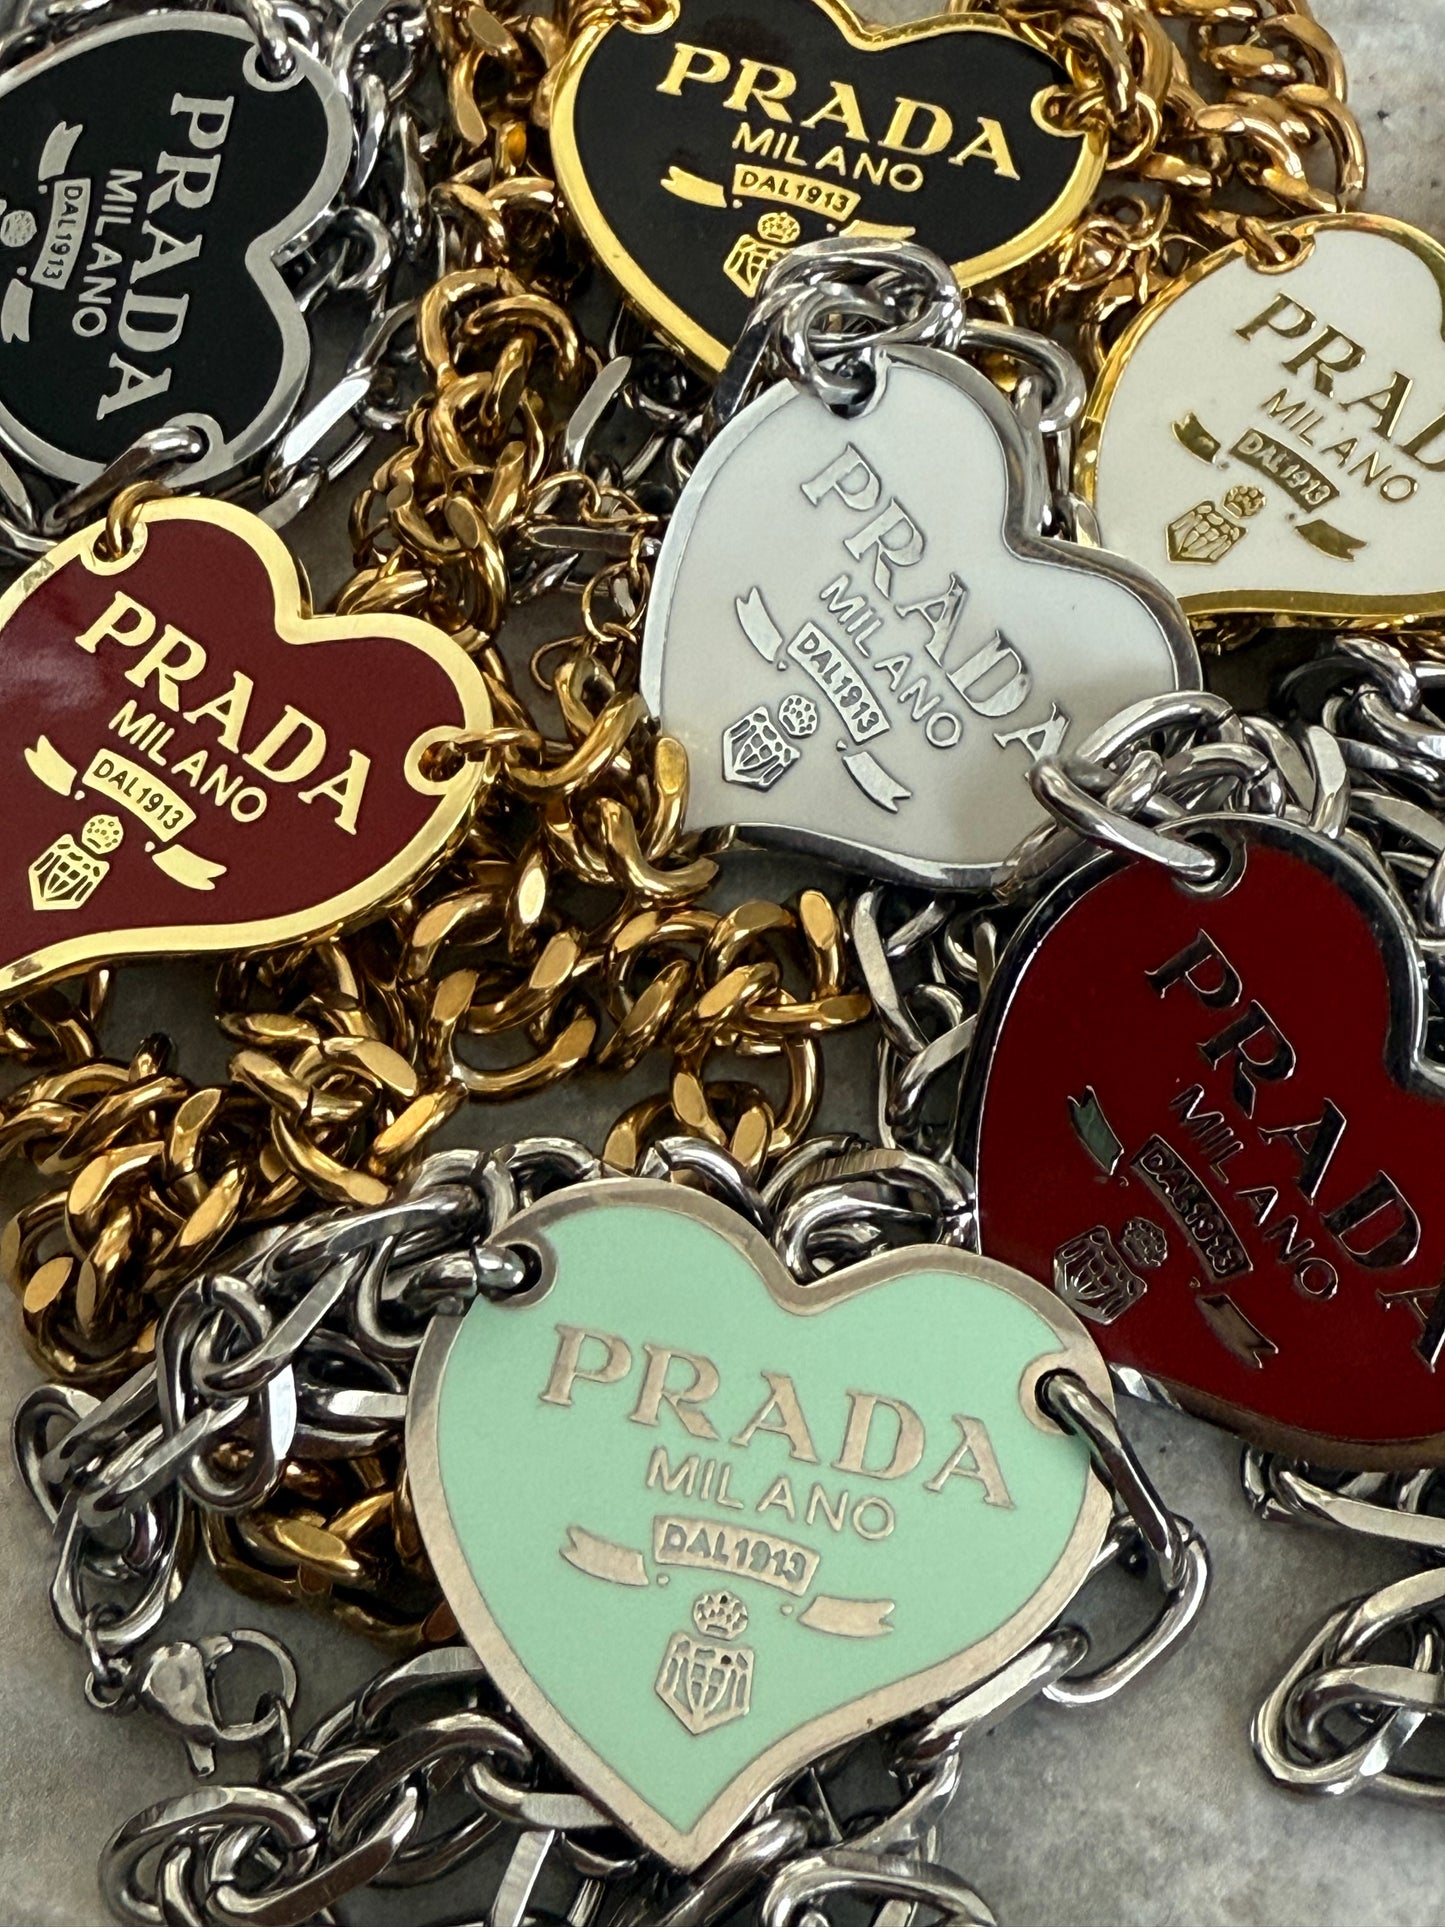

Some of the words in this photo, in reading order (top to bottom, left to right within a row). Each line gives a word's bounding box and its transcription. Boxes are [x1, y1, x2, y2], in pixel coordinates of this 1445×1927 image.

[655, 42, 1021, 181] PRADA
[732, 122, 924, 193] MILANO
[72, 168, 143, 337] MILANO
[97, 92, 235, 421] PRADA
[1260, 387, 1420, 504] MILANO
[75, 590, 372, 836] PRADA
[819, 573, 964, 749] MILANO
[108, 700, 268, 823] MILANO
[1169, 1082, 1339, 1300] MILANO
[537, 1323, 1018, 1510] PRADA
[646, 1445, 897, 1541] MILANO
